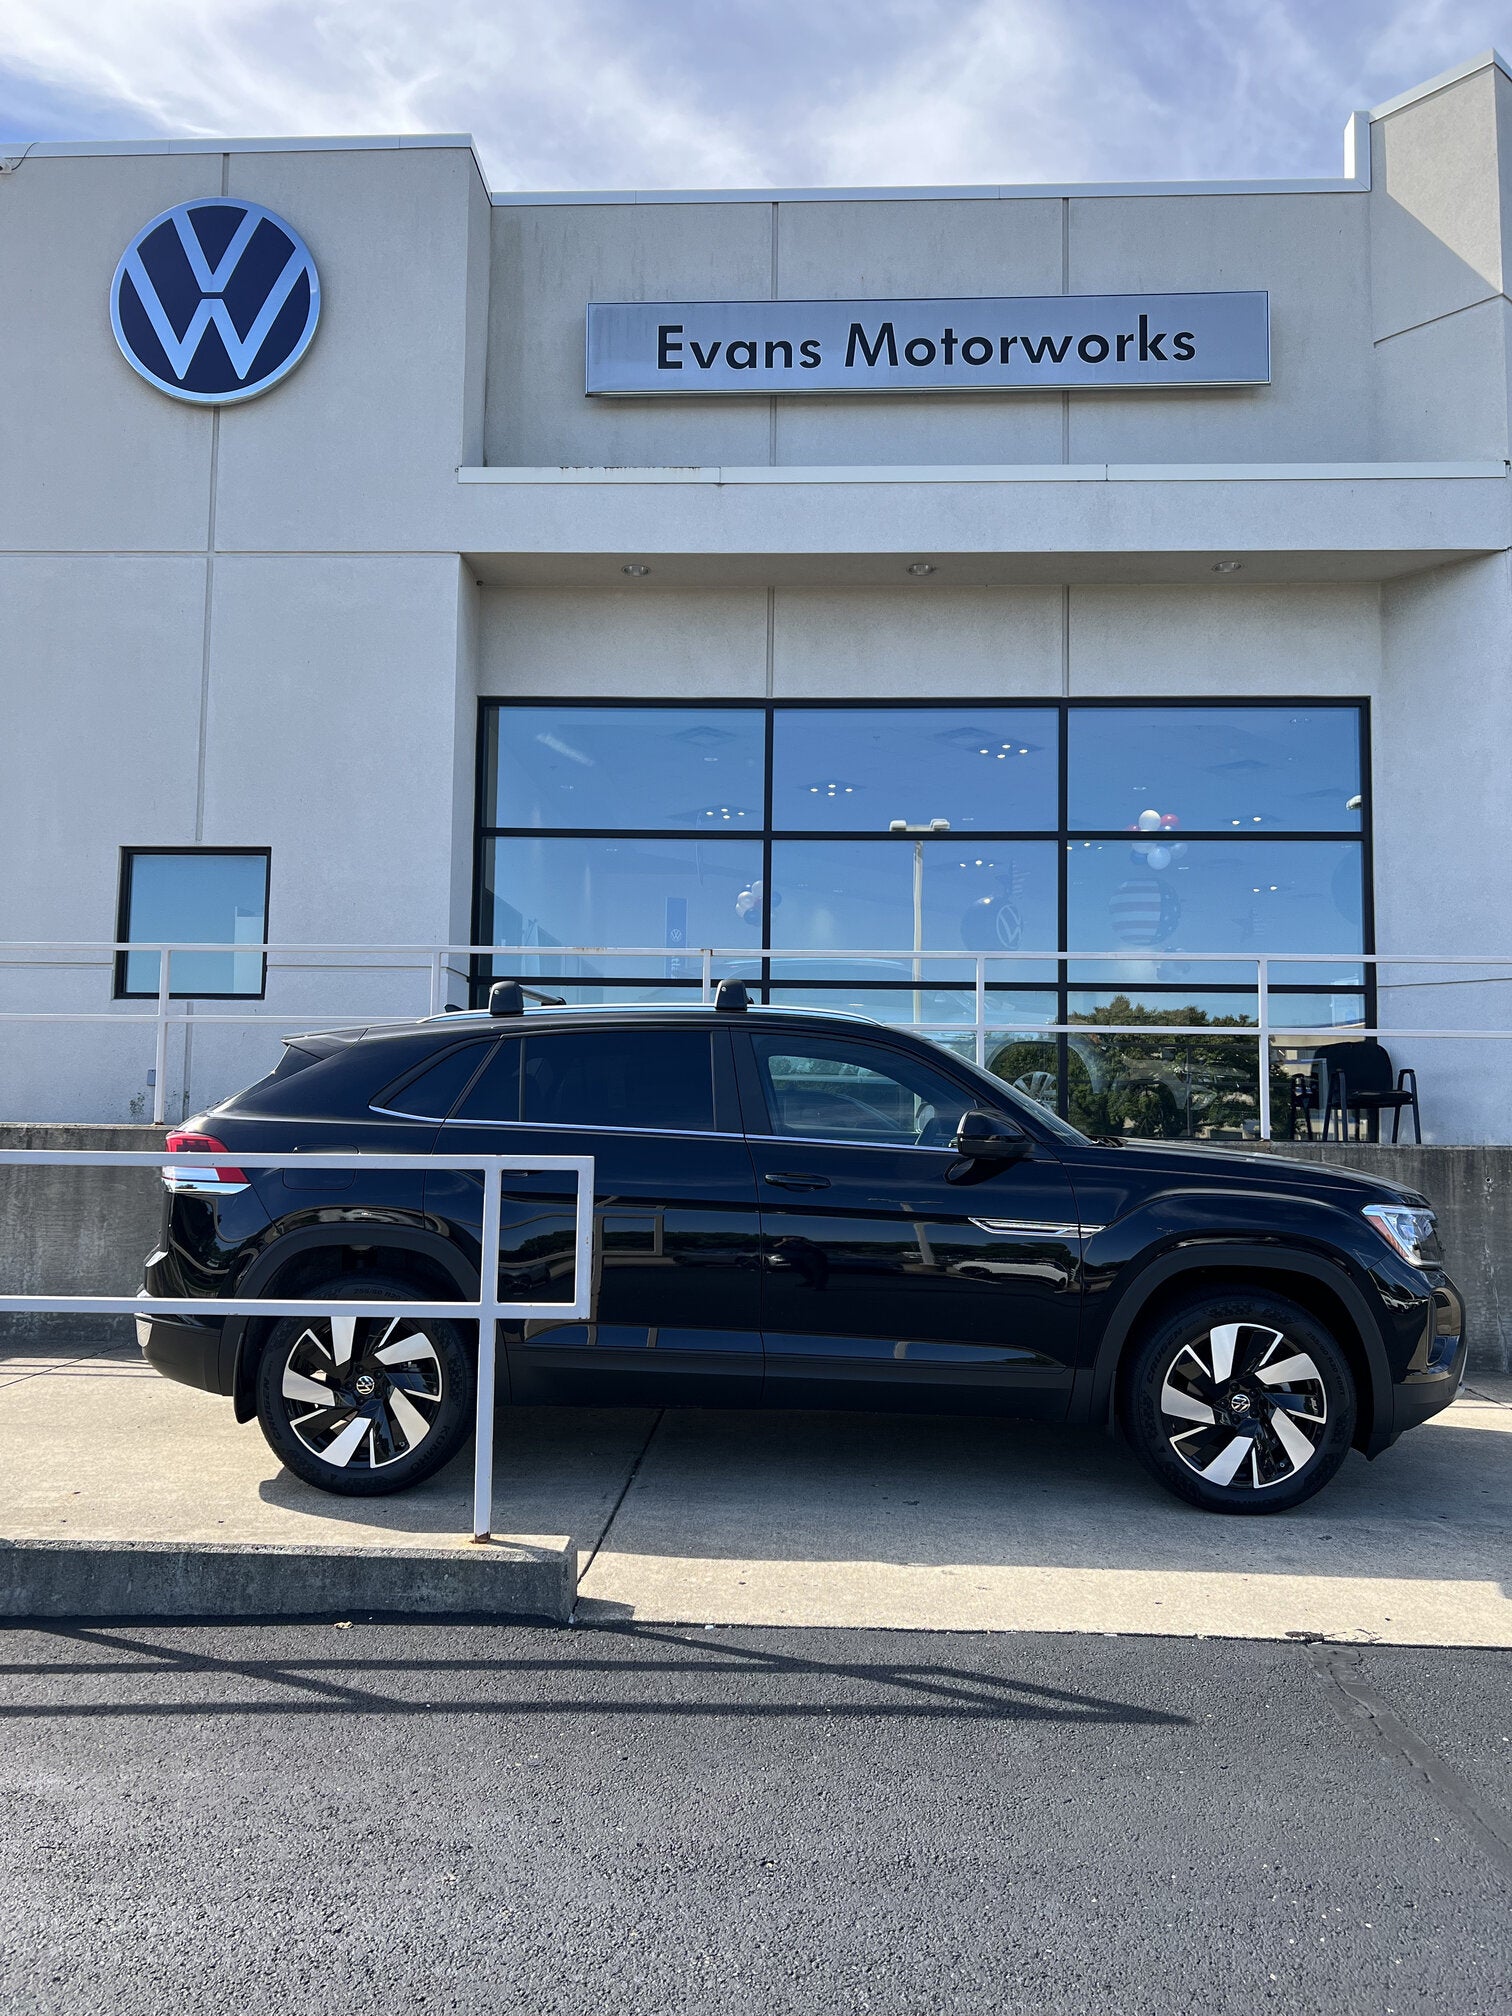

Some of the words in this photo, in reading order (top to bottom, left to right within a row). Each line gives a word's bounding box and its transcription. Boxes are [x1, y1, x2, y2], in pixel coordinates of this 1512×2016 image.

[108, 196, 321, 404] VW
[656, 324, 822, 371] Evans
[844, 313, 1197, 369] Motorworks
[1147, 1327, 1182, 1384] CRUGEN
[410, 1425, 451, 1472] KUMHO
